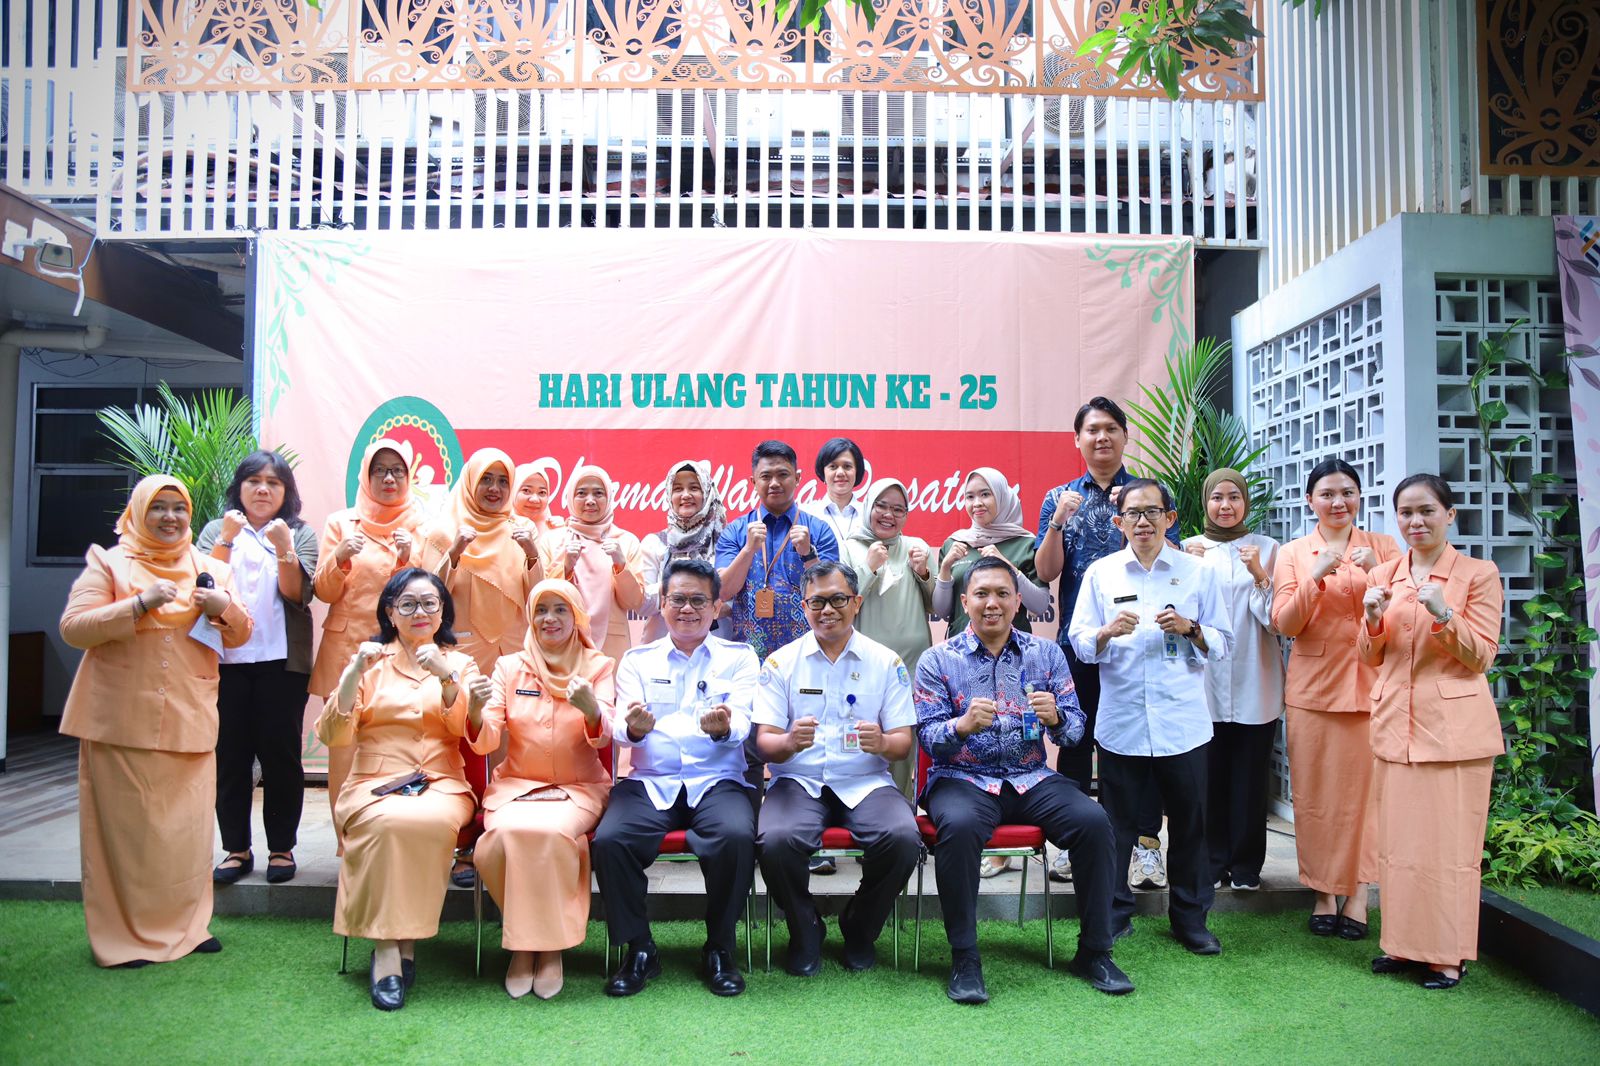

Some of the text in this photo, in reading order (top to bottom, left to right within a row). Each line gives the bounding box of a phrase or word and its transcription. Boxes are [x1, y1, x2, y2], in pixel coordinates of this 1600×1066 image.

[539, 372, 998, 411] HARI ULANG TAHUN KE - 25
